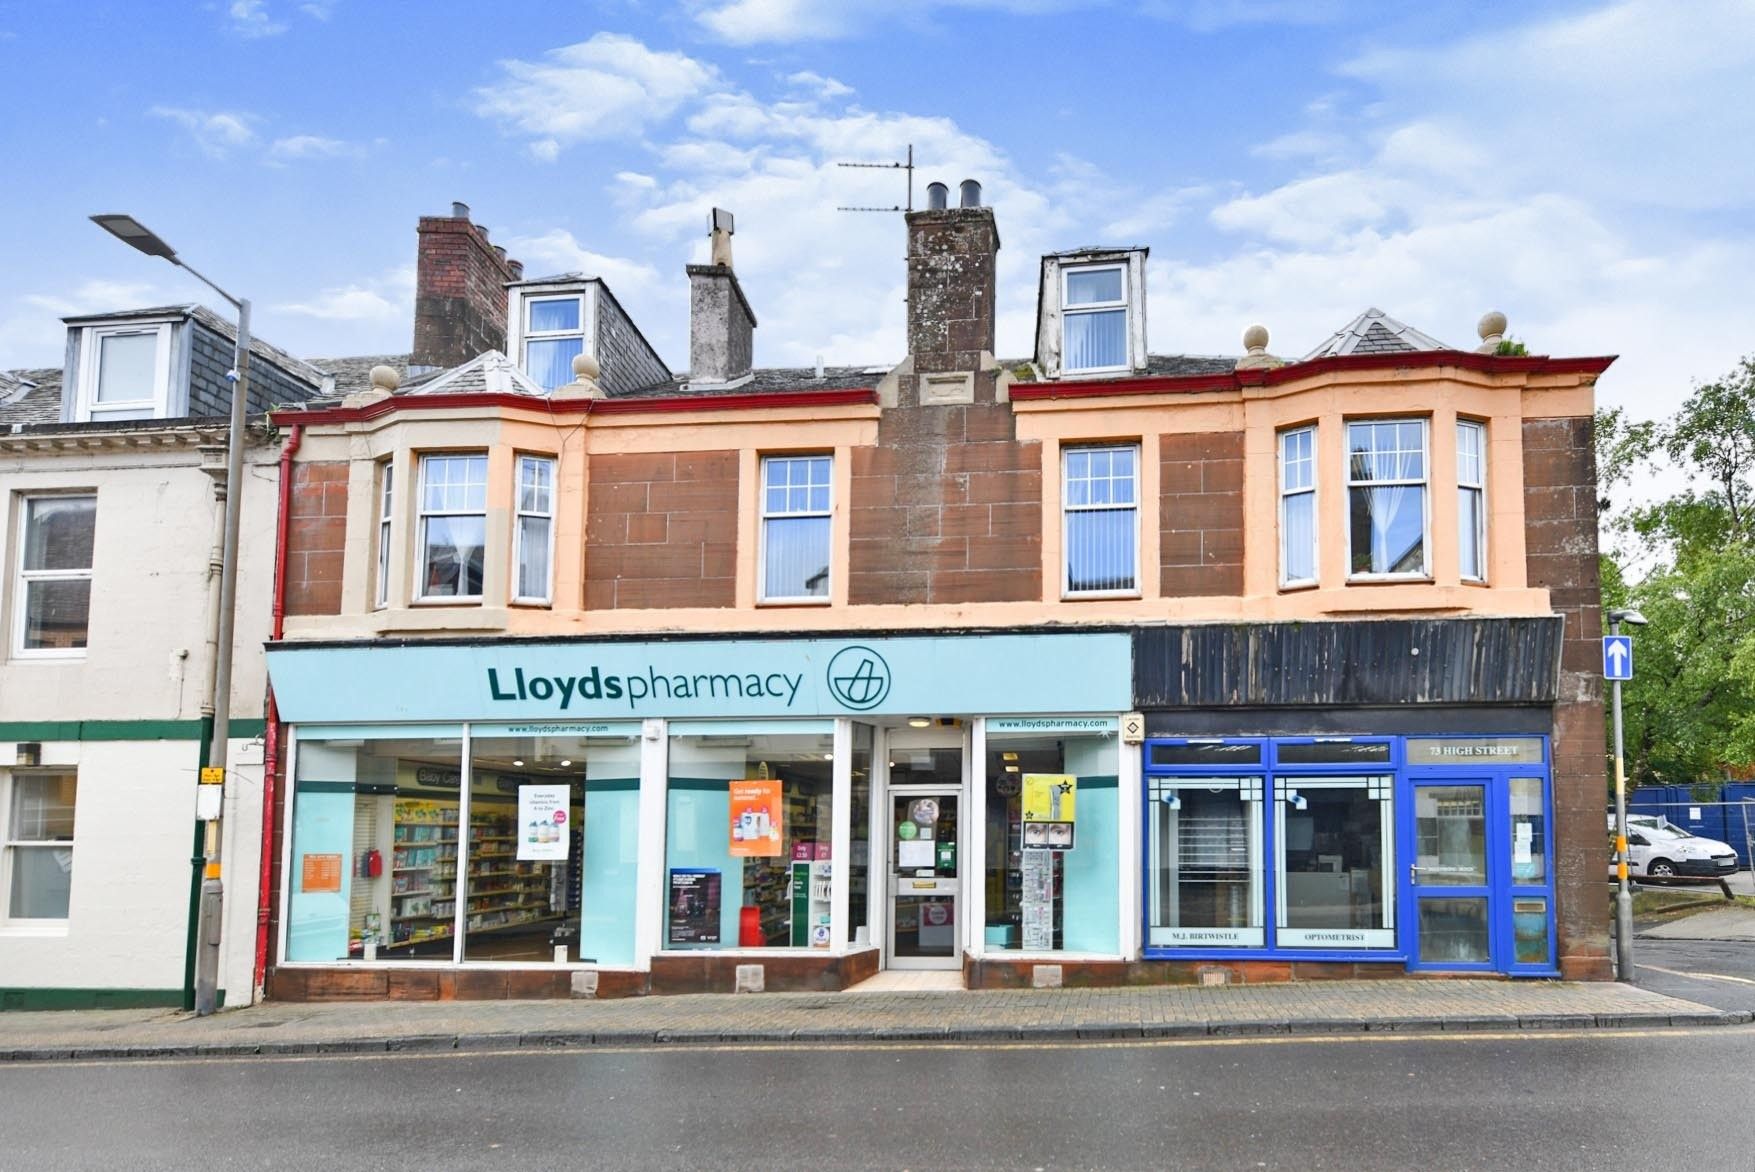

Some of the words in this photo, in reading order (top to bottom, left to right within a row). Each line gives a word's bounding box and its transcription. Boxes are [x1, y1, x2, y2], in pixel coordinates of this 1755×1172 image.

[487, 665, 803, 710] Lloydspharmacy
[508, 724, 609, 734] www.lloydspharmacy.com
[999, 719, 1108, 729] www.lloydspharmacy.com
[1430, 746, 1441, 756] 73
[1443, 746, 1473, 756] HIGH
[1475, 745, 1519, 755] STREET
[1189, 932, 1238, 940] BIRTWISTLE
[1304, 933, 1365, 941] OPTOMETRIST
